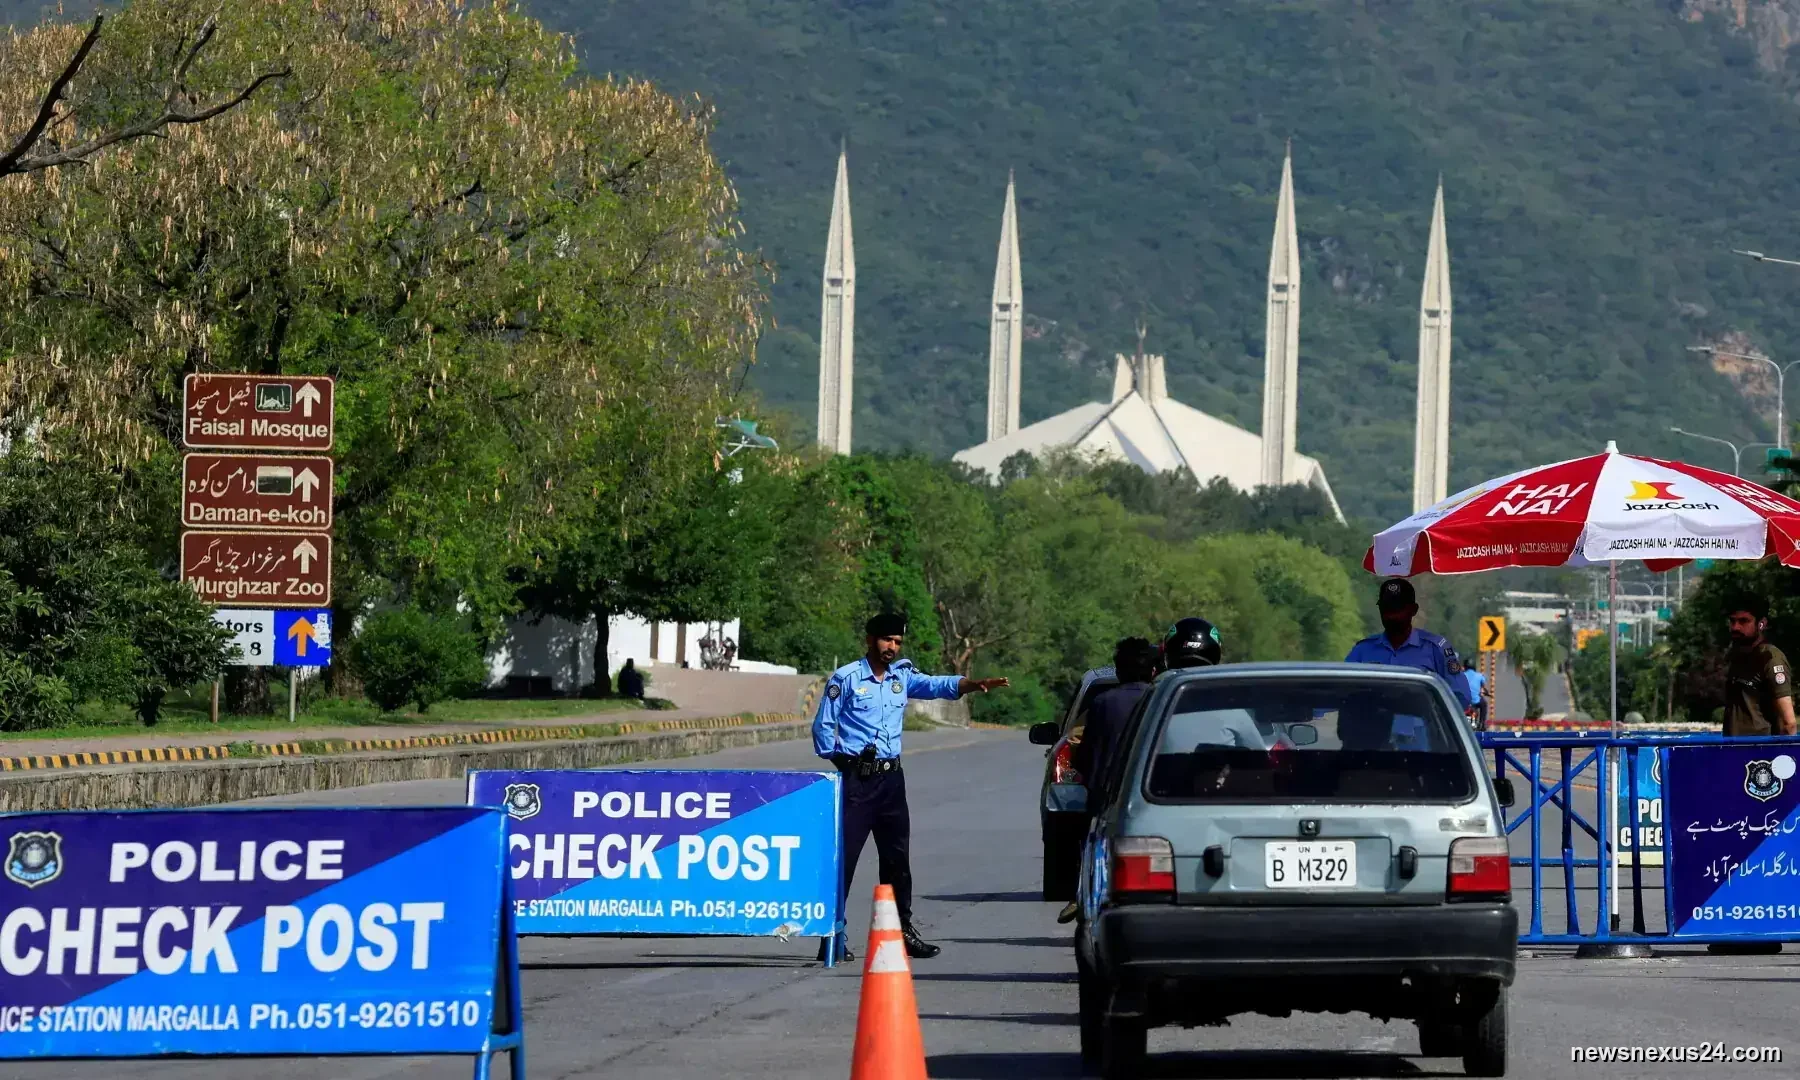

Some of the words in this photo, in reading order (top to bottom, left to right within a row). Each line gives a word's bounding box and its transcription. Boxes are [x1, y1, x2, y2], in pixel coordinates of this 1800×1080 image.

[188, 388, 221, 417] مسجد
[215, 380, 251, 415] فیصل
[189, 417, 245, 437] Faisal
[251, 418, 329, 442] Mosque
[1504, 481, 1589, 500] HAI
[189, 502, 326, 524] Daman-e-koh
[1485, 498, 1570, 517] NA!
[1622, 501, 1720, 512] JazzCash
[1456, 545, 1491, 559] JAZZCASH
[1608, 538, 1642, 550] JAZZCASH
[1643, 538, 1656, 549] HAI
[1657, 537, 1668, 548] NA
[1673, 537, 1709, 549] JAZZCASH
[1711, 538, 1724, 549] HAI
[1725, 538, 1739, 550] NA!
[187, 576, 281, 599] Murghzar
[285, 577, 325, 596] Zoo
[573, 791, 731, 819] POLICE
[109, 839, 345, 883] POLICE
[509, 833, 662, 880] CHECK
[677, 834, 800, 881] POST
[1273, 859, 1285, 882] B
[1298, 858, 1348, 882] M329
[528, 899, 585, 917] STATION
[588, 899, 664, 917] MARGALLA
[670, 900, 826, 919] Ph.051-9261510
[1692, 904, 1800, 921] 051-926151
[0, 901, 243, 976] CHECK
[261, 901, 445, 973] POST
[38, 1005, 123, 1032] STATION
[127, 1004, 240, 1031] MARGALLA
[249, 1000, 480, 1029] Ph.051-9261510
